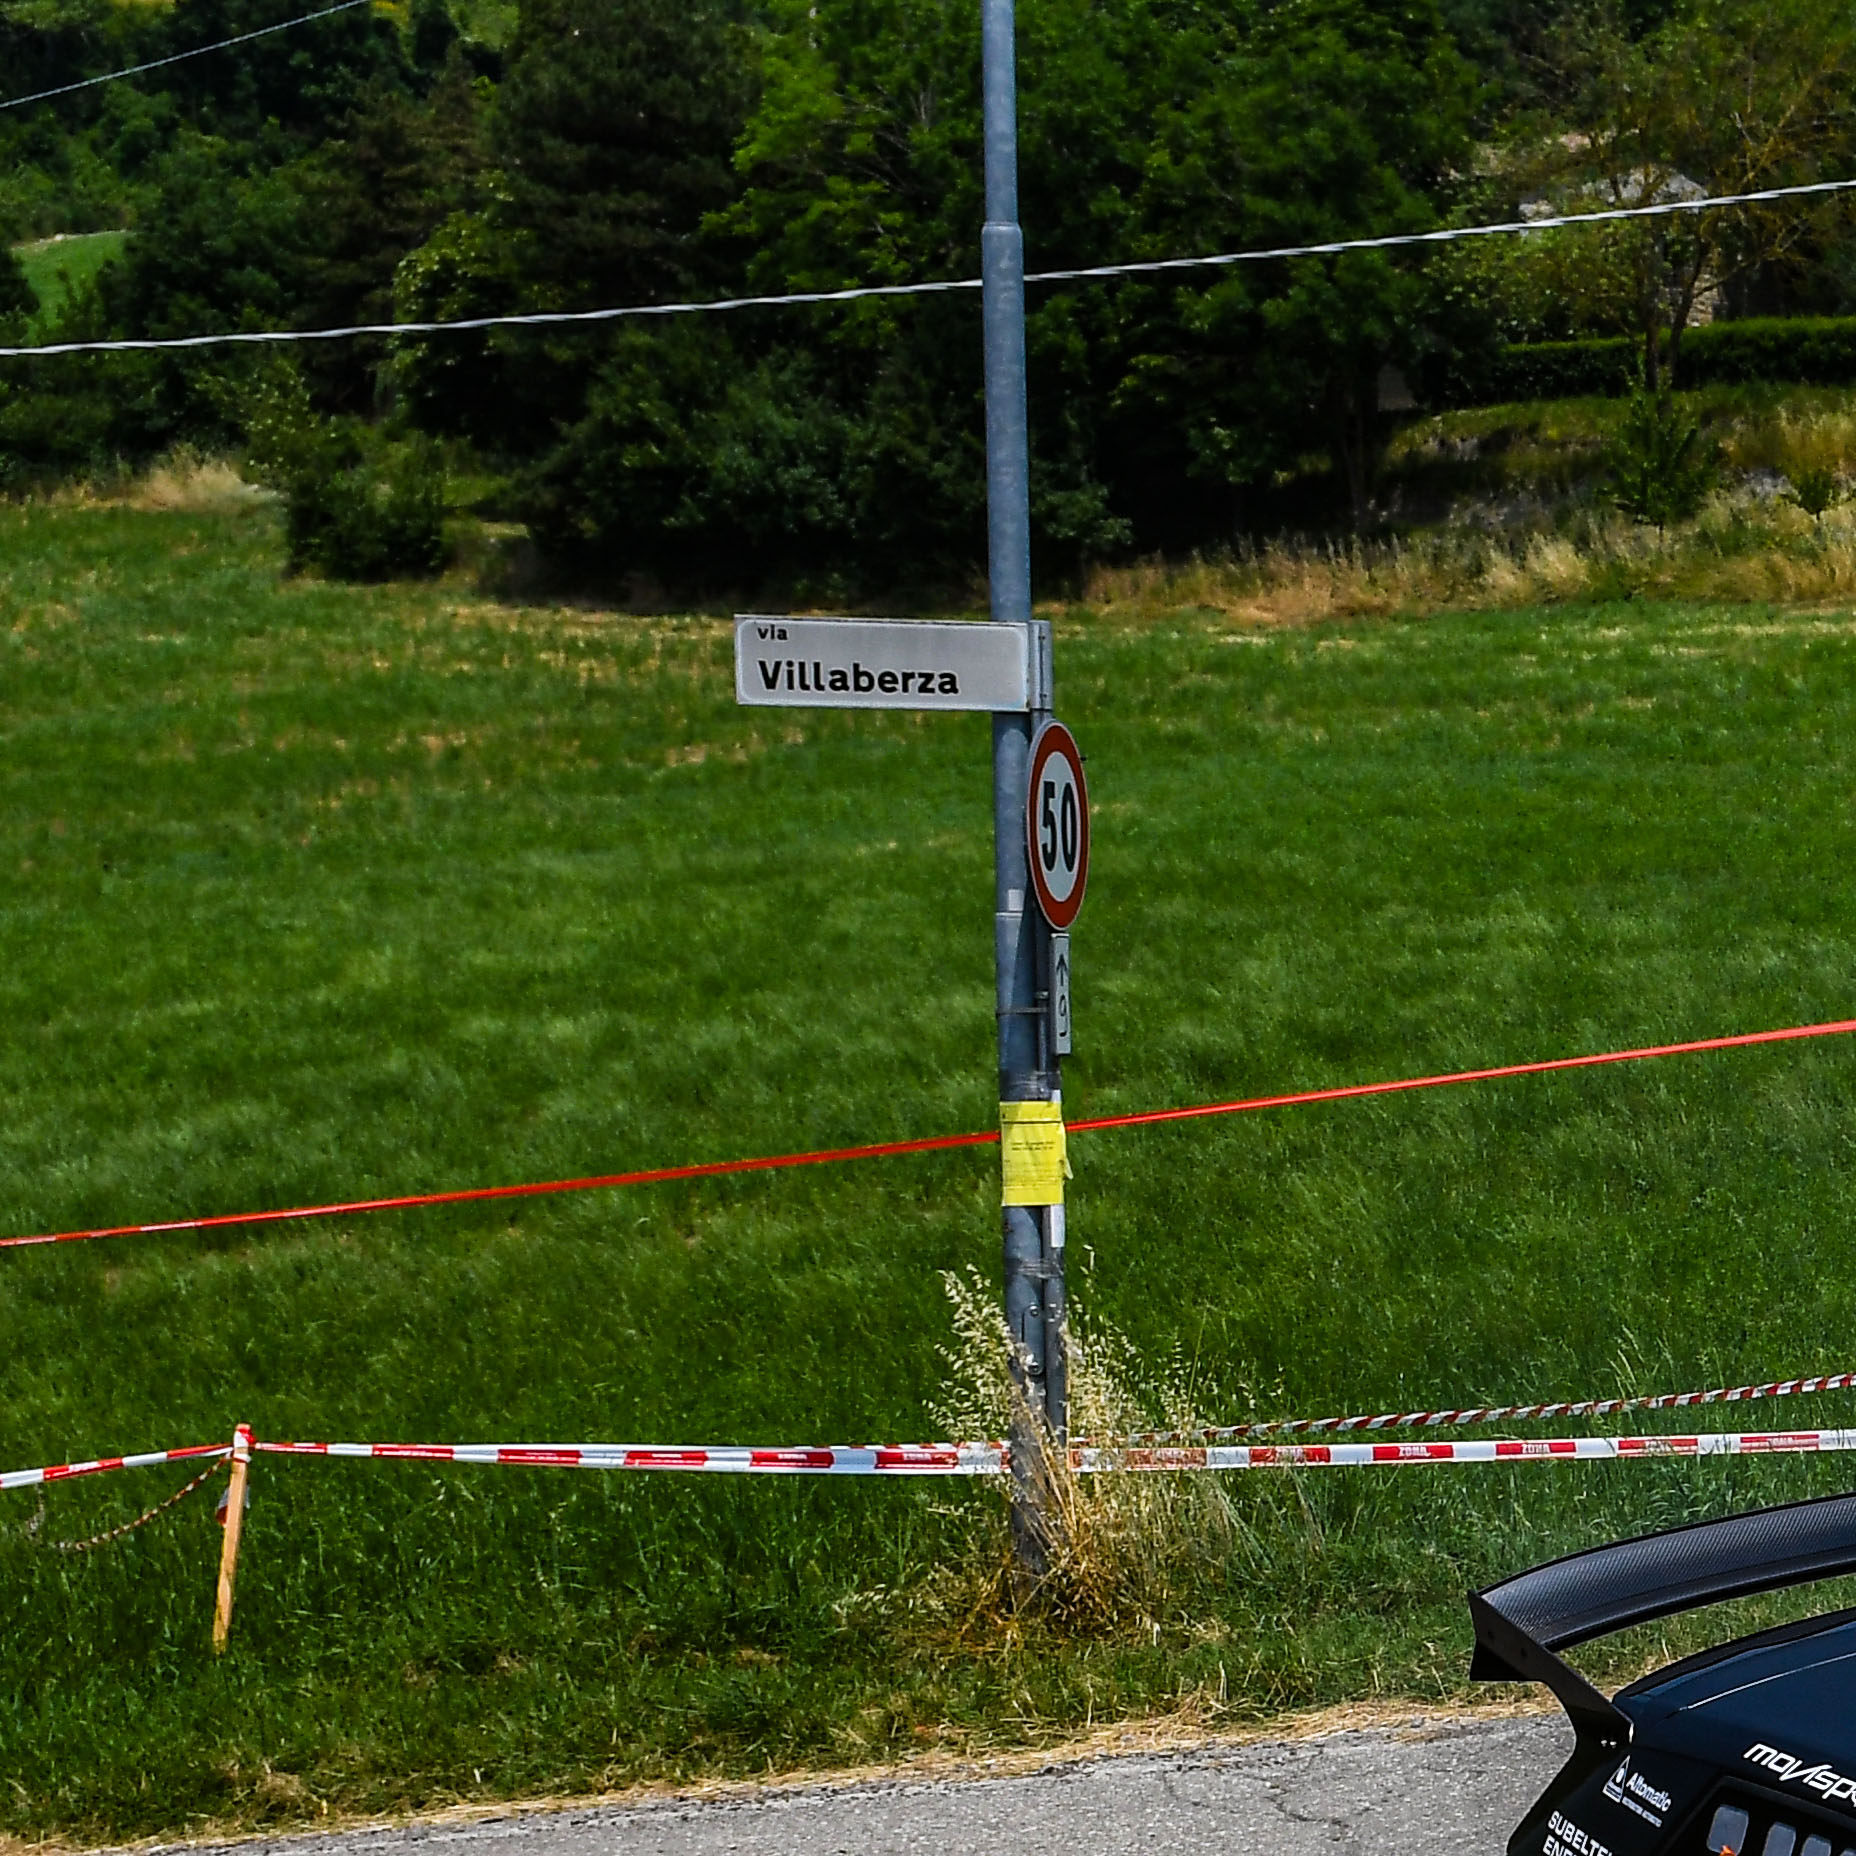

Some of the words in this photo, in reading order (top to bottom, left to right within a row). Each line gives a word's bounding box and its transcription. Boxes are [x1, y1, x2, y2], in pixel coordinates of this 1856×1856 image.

[757, 624, 788, 641] via
[758, 660, 960, 696] Villaberza
[1042, 780, 1078, 873] 50
